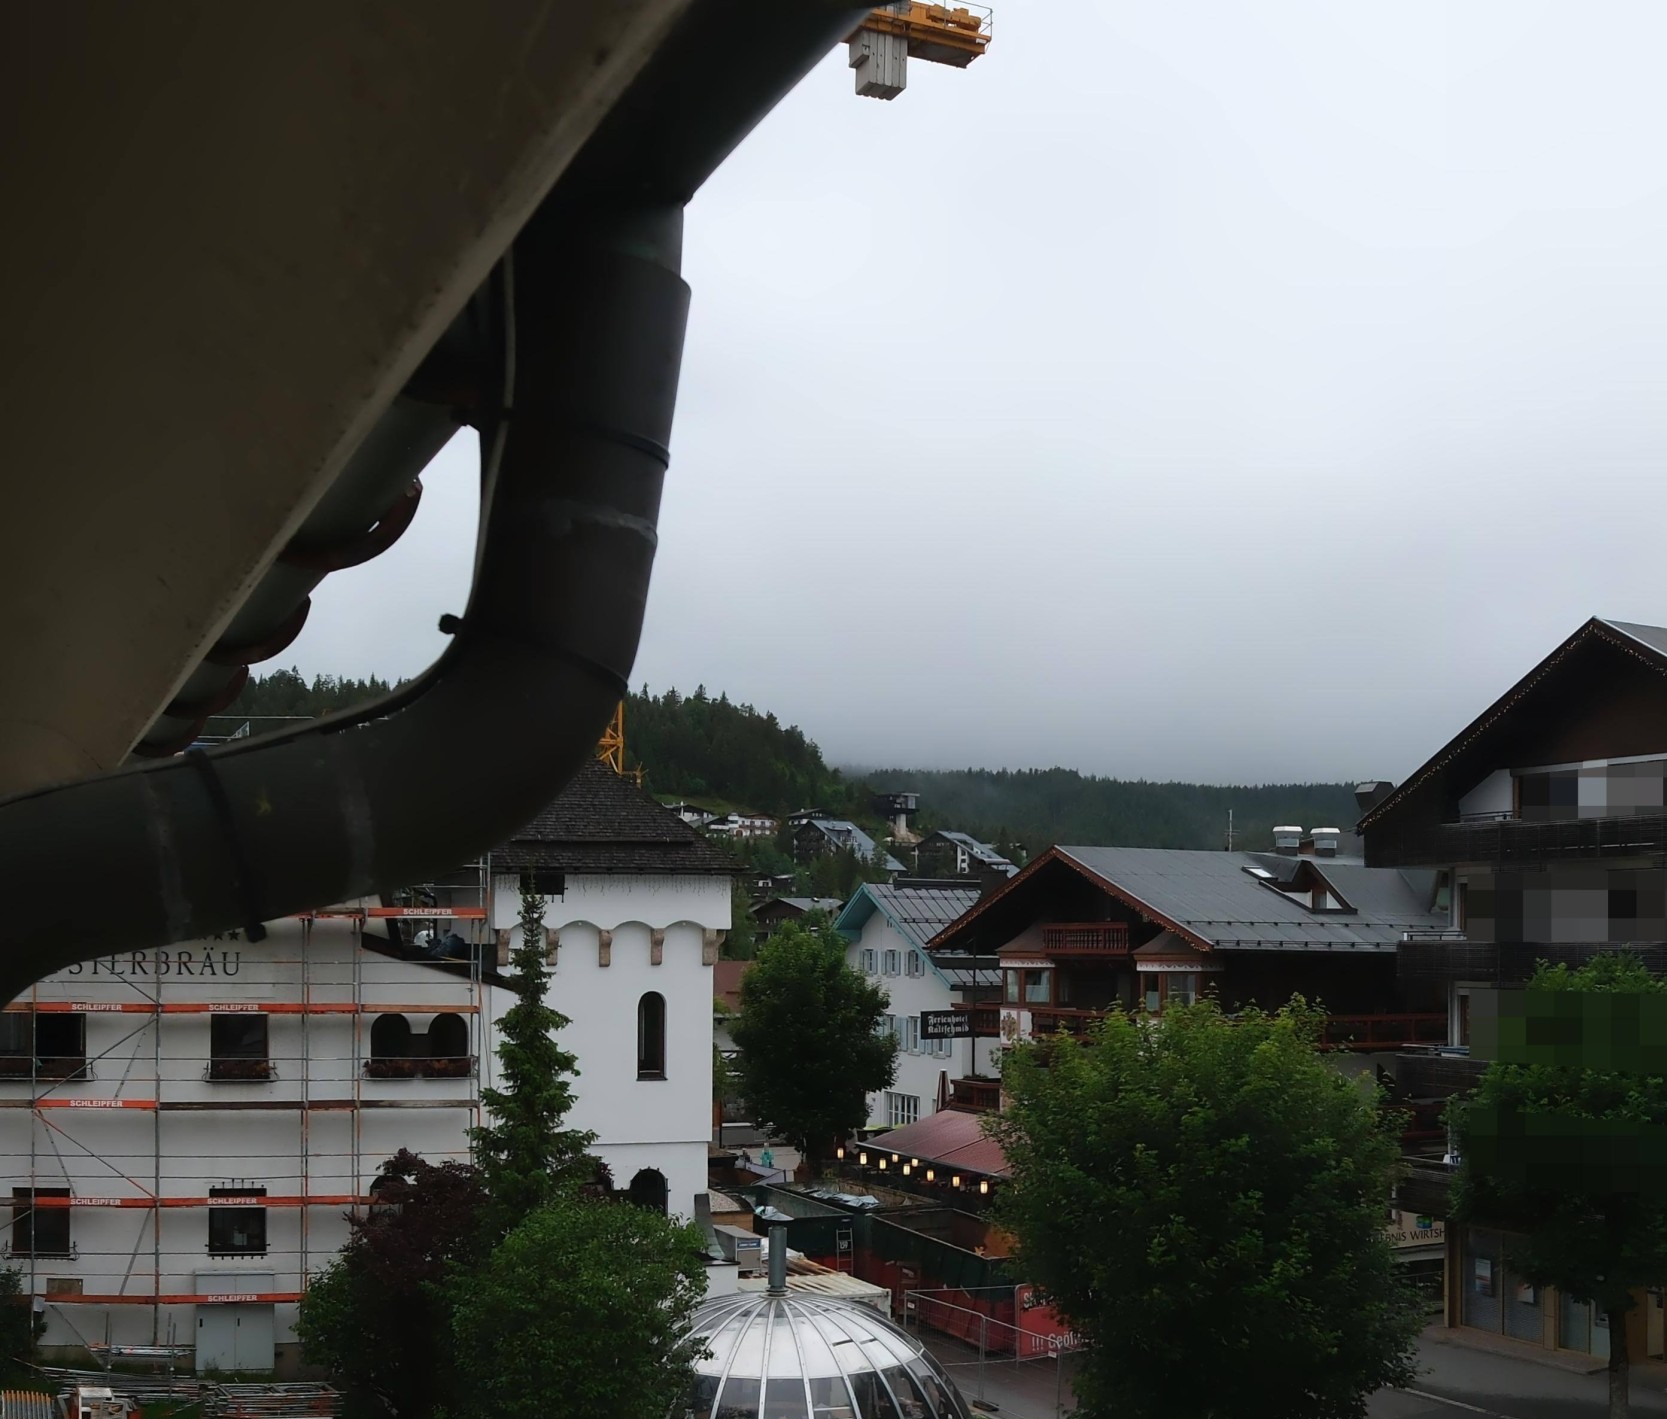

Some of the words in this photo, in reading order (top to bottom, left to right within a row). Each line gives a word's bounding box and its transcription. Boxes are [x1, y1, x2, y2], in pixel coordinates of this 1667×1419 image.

[403, 908, 452, 916] SCHLEIPFER
[69, 947, 241, 977] STERBRÄU
[70, 1100, 123, 1108] SCHLEIPFER
[1410, 1228, 1445, 1241] WIRTSH
